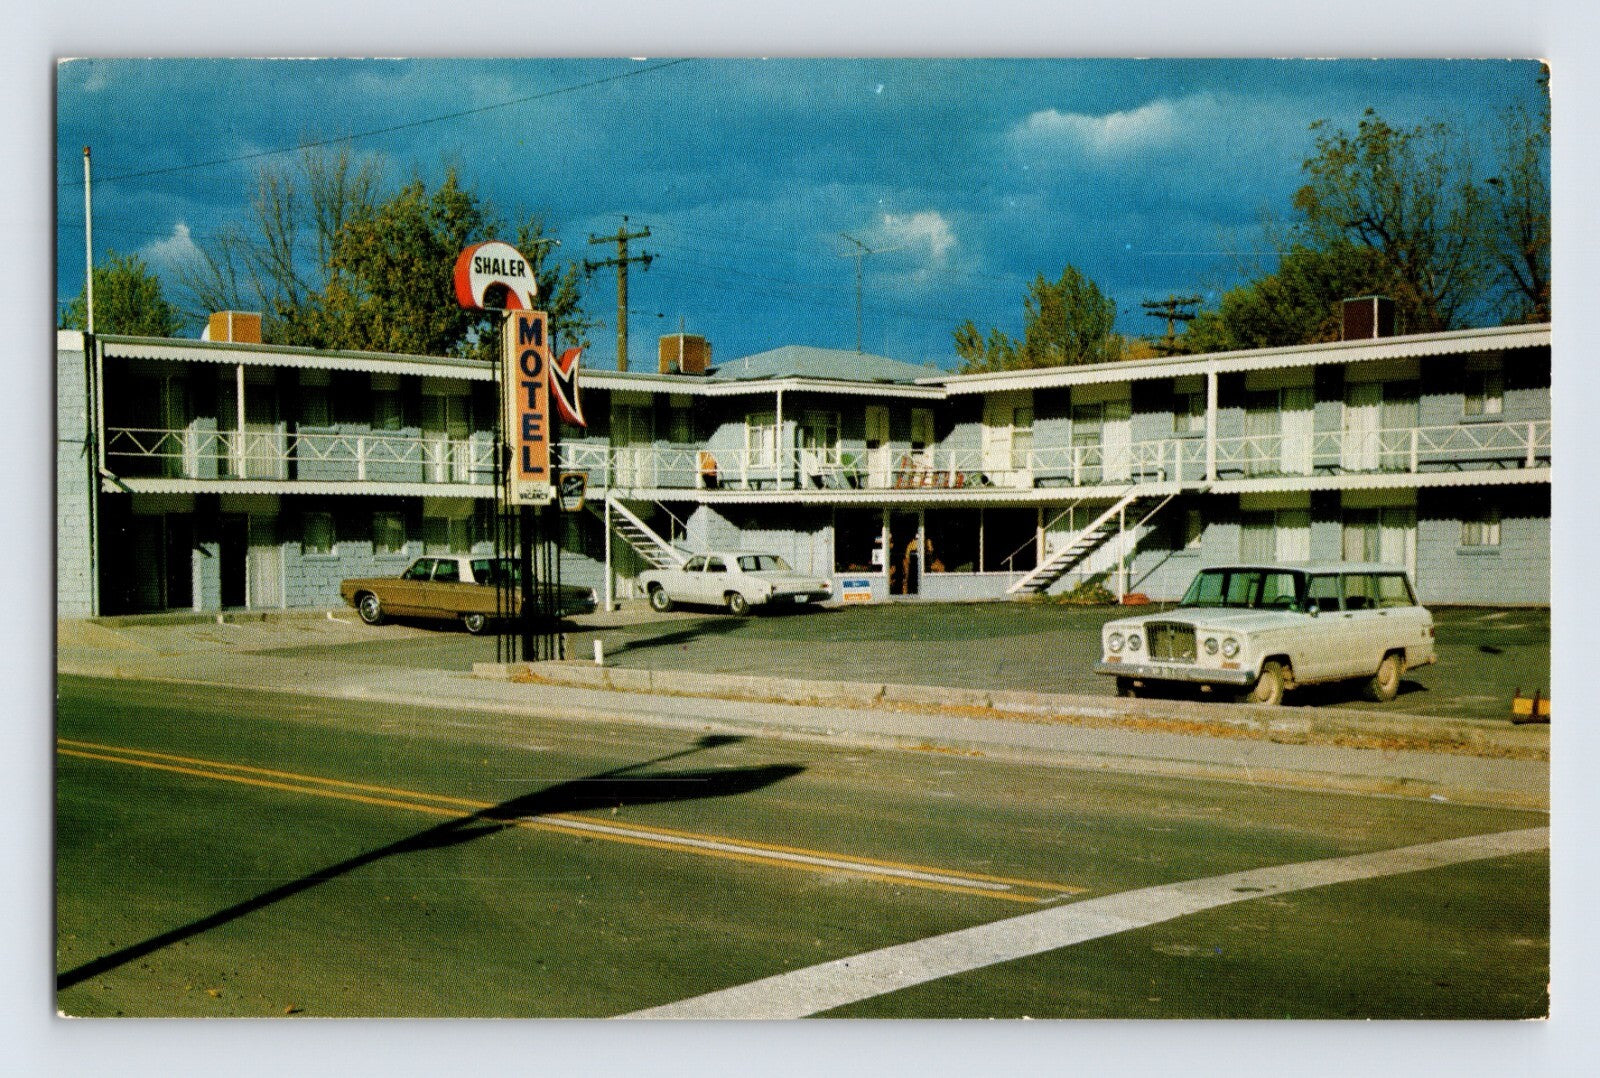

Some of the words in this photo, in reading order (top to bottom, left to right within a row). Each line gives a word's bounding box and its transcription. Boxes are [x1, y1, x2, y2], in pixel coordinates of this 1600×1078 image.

[474, 256, 526, 278] SHALER
[519, 316, 544, 474] MOTEL
[519, 492, 549, 500] VACANCY
